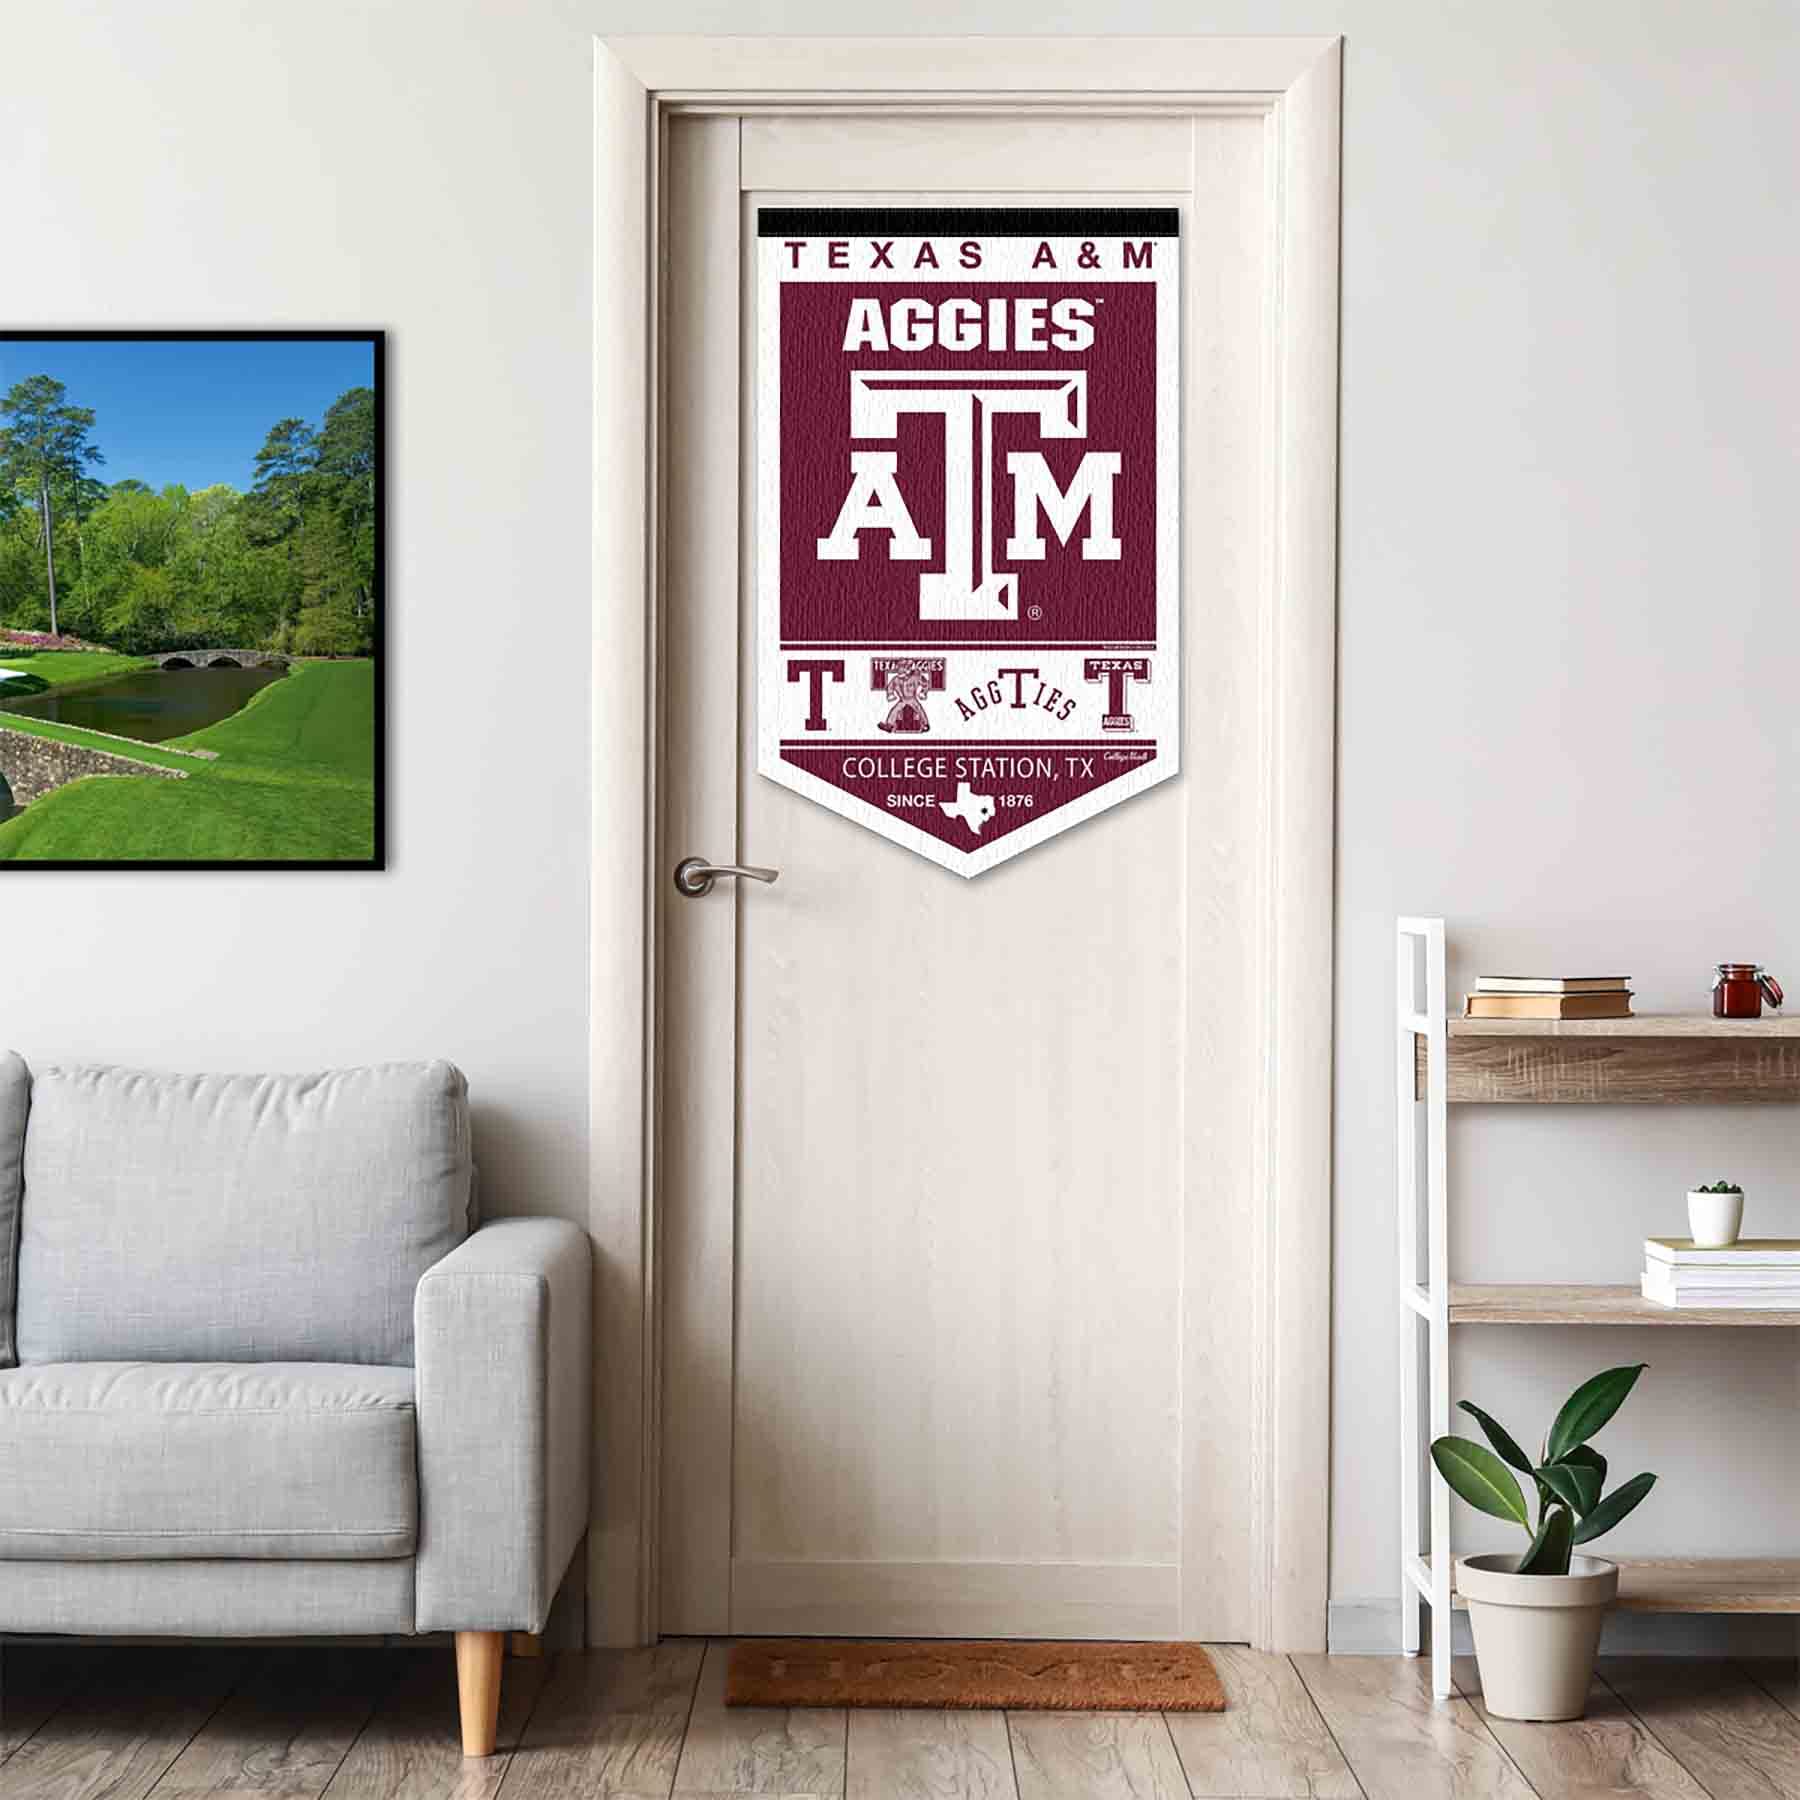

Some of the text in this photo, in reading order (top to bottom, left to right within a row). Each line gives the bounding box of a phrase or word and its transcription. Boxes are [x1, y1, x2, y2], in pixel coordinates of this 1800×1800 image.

[784, 241, 982, 269] TEXAS
[842, 298, 1095, 352] AGGIES
[1089, 660, 1144, 671] TEXAS
[787, 660, 845, 731] T
[843, 757, 1095, 782] COLLEGE STATION, TX
[886, 793, 936, 808] SINCE
[998, 793, 1034, 808] 1876
